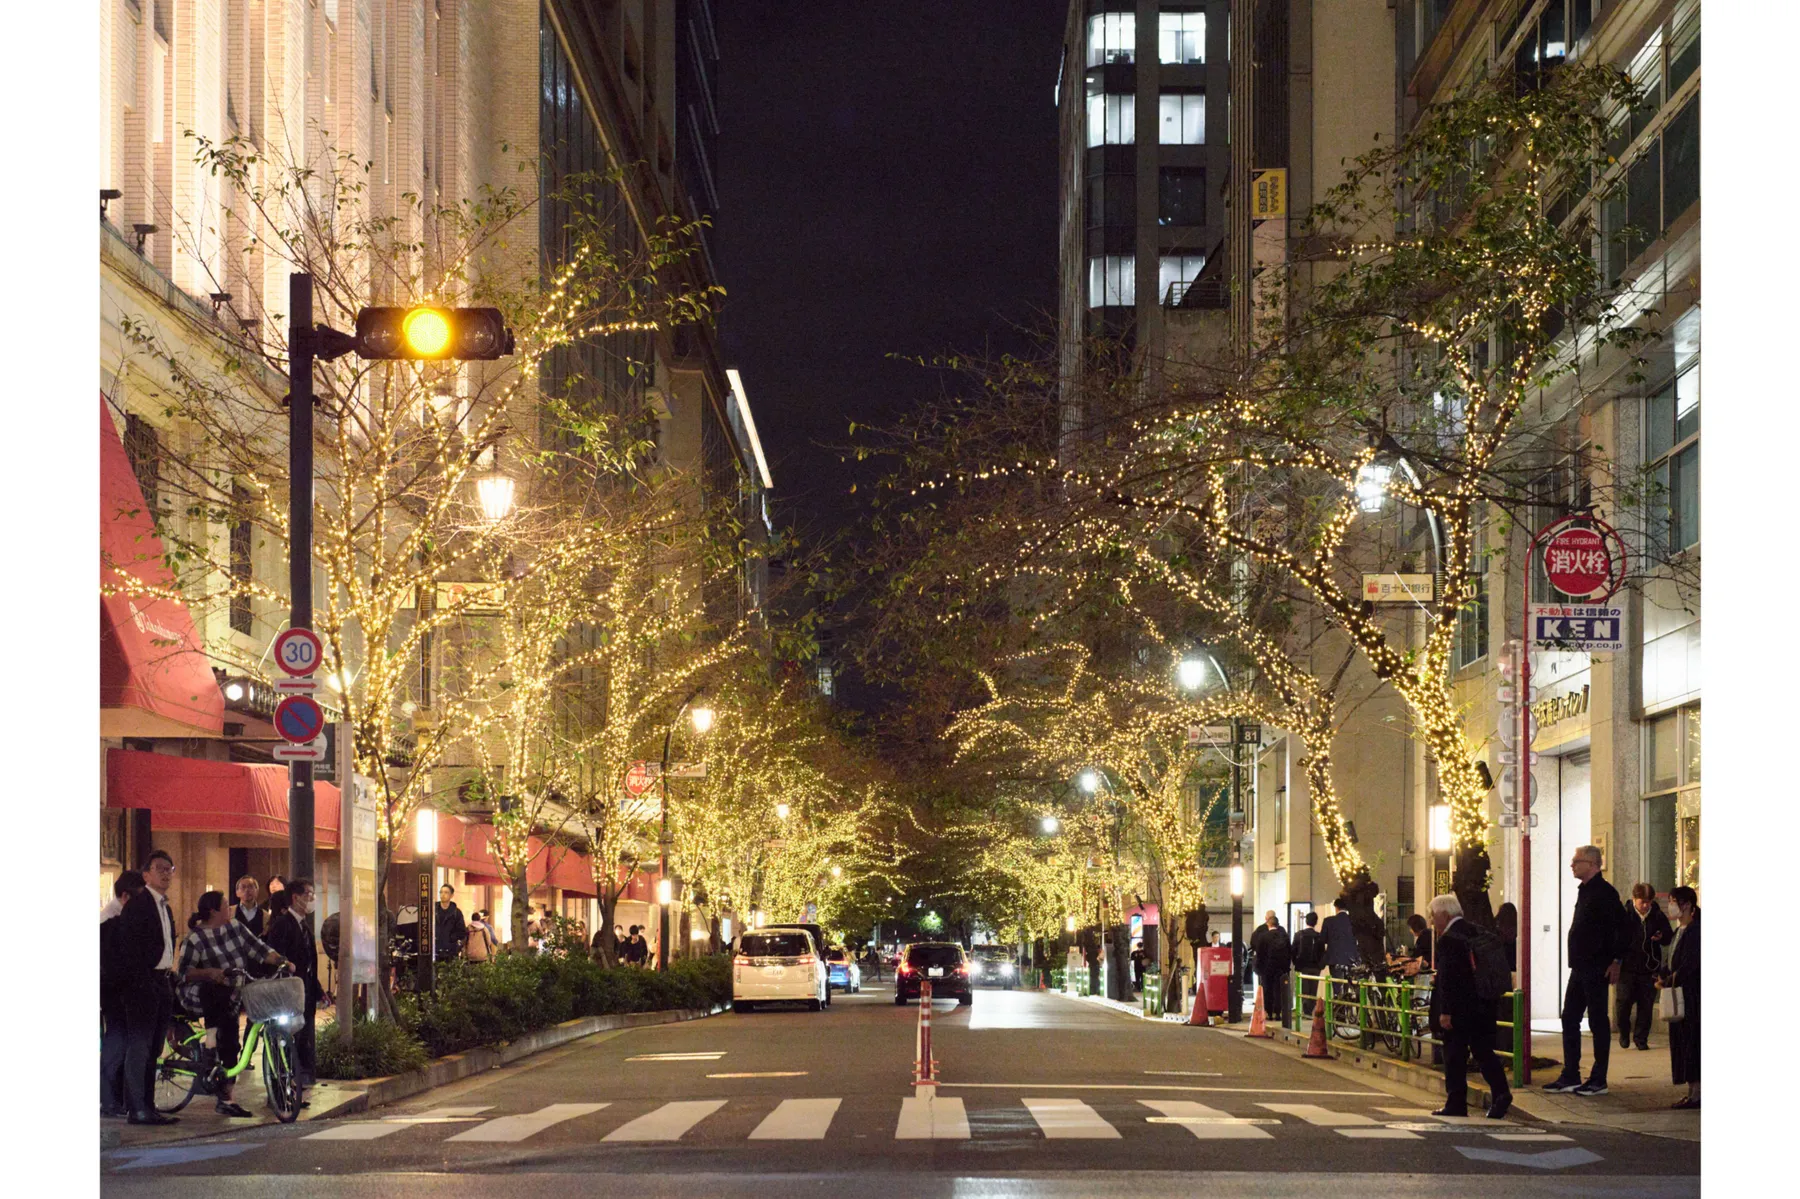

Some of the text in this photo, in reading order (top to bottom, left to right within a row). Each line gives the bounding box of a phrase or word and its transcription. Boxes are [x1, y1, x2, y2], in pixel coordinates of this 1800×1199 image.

[1572, 538, 1600, 546] HYDRANT
[1551, 549, 1607, 574] 消火栓
[1536, 608, 1621, 617] 不動産は信頼の
[1544, 620, 1612, 639] KEN
[285, 642, 313, 663] 30
[1244, 731, 1257, 741] 81
